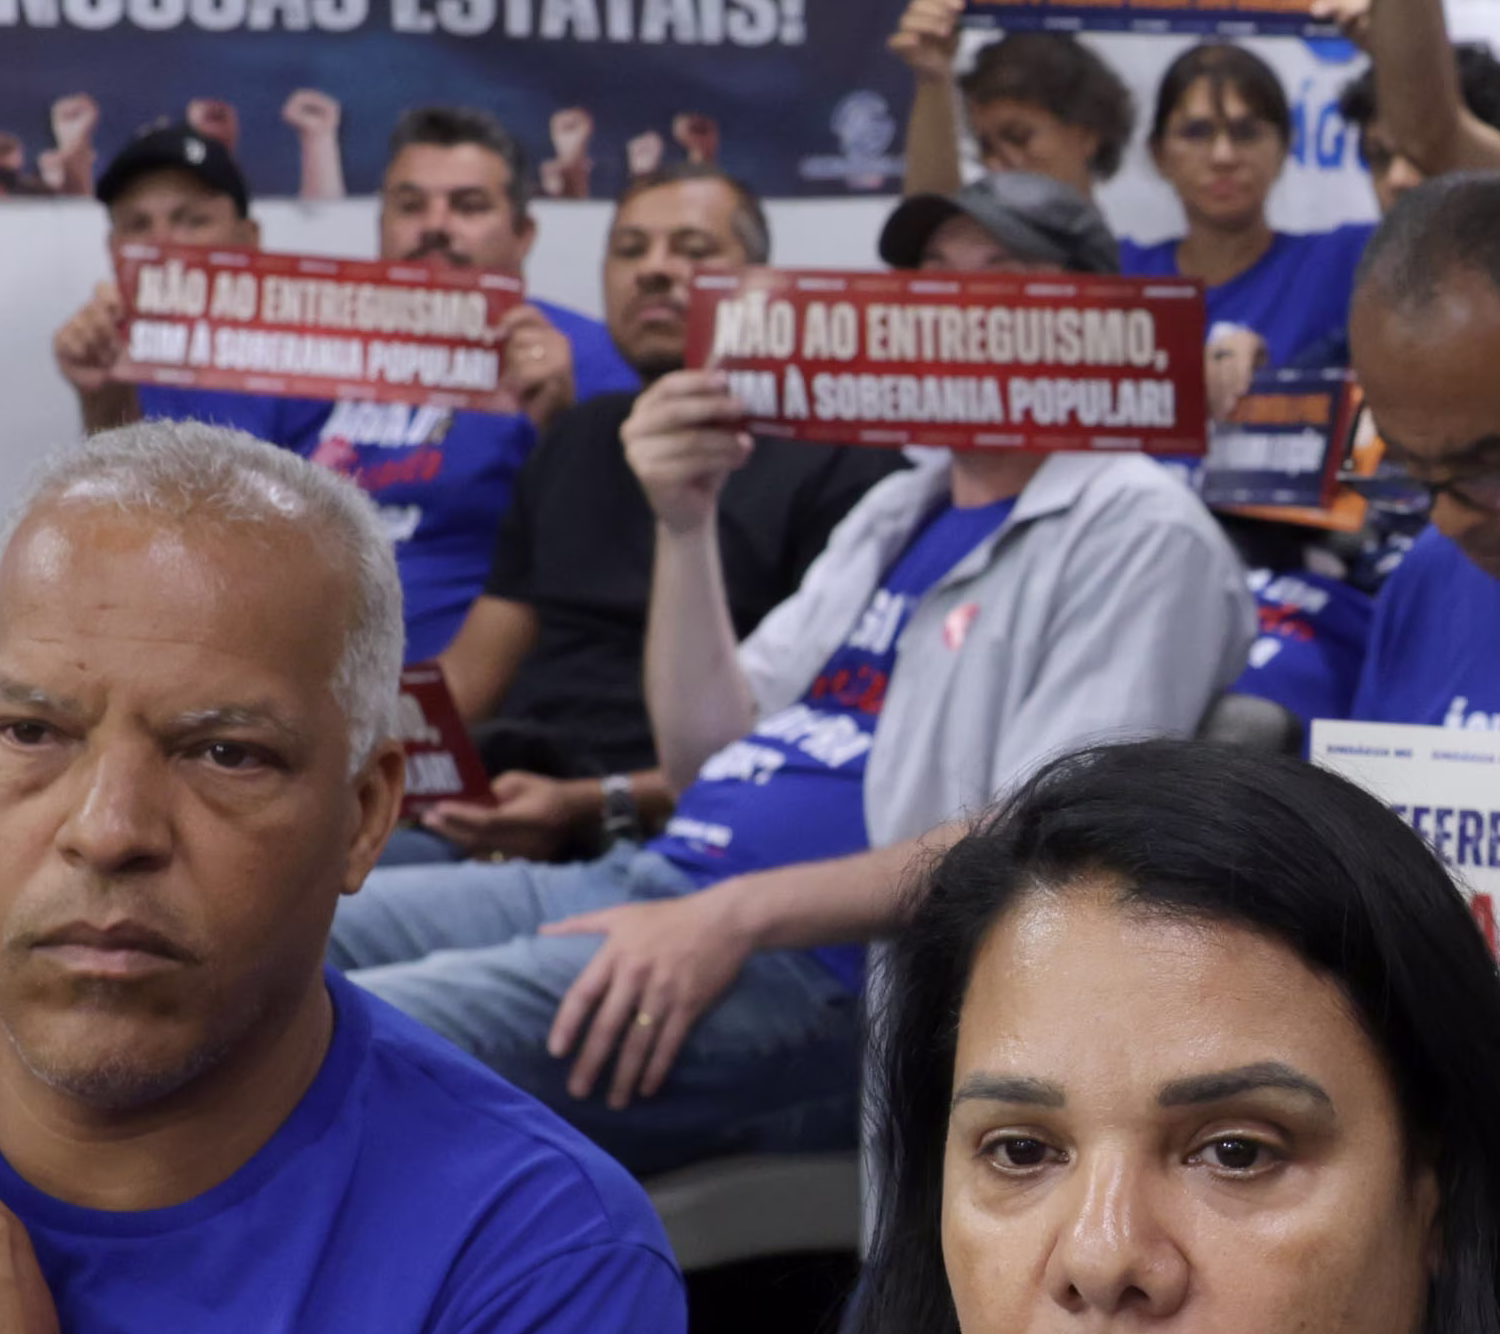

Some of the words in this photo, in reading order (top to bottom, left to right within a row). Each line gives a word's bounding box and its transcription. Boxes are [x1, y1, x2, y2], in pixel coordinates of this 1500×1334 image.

[136, 261, 208, 316] NÃO
[210, 271, 257, 320] AO
[714, 291, 795, 358] NÃO
[803, 298, 859, 360] AO
[866, 305, 1168, 369] ENTREGUISMO,
[784, 368, 809, 418] À
[814, 373, 1001, 421] SOBERANIA
[1009, 381, 1175, 427] POPULAR!
